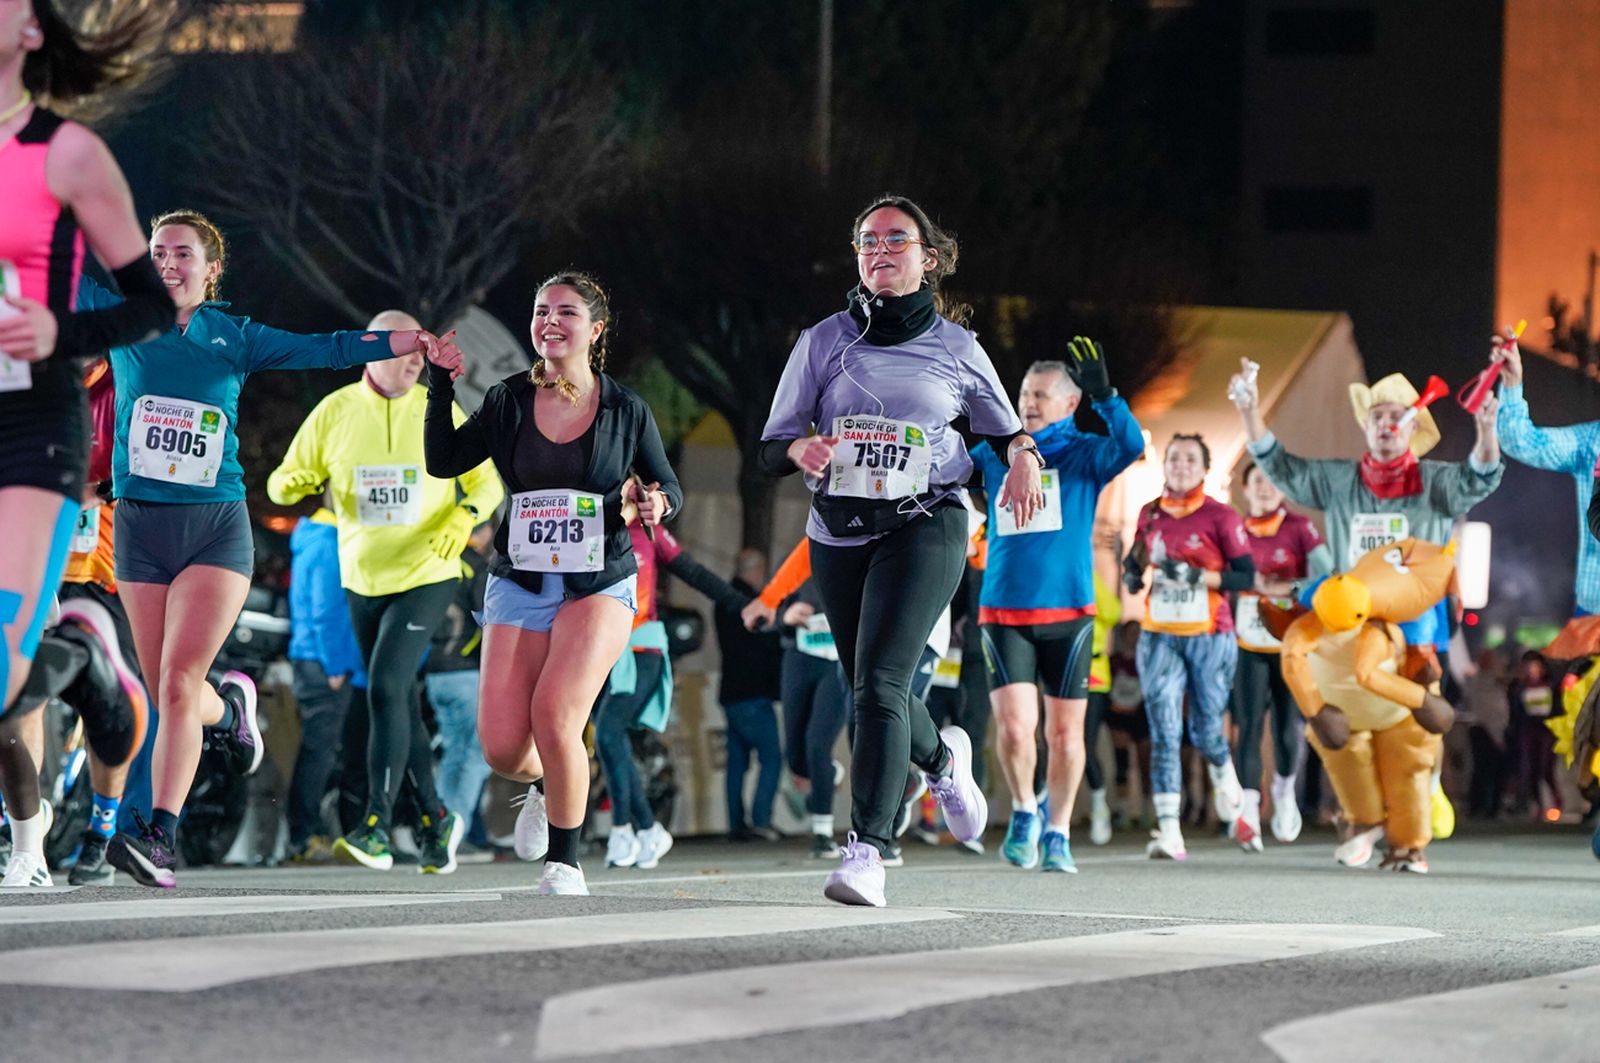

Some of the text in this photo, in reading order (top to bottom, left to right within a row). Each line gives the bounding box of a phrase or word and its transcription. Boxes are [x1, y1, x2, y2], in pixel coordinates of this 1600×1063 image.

[155, 406, 183, 417] NOCHE
[184, 410, 195, 419] DE
[143, 414, 161, 425] SAN
[162, 416, 193, 429] ANTÓN
[146, 426, 207, 458] 6905
[844, 431, 863, 441] SAN
[854, 442, 911, 472] 7507
[368, 487, 408, 504] 4510
[531, 498, 556, 508] NOCHE
[558, 497, 569, 507] DE
[520, 509, 537, 519] SAN
[540, 507, 568, 518] ANTÓN
[528, 519, 584, 544] 6213
